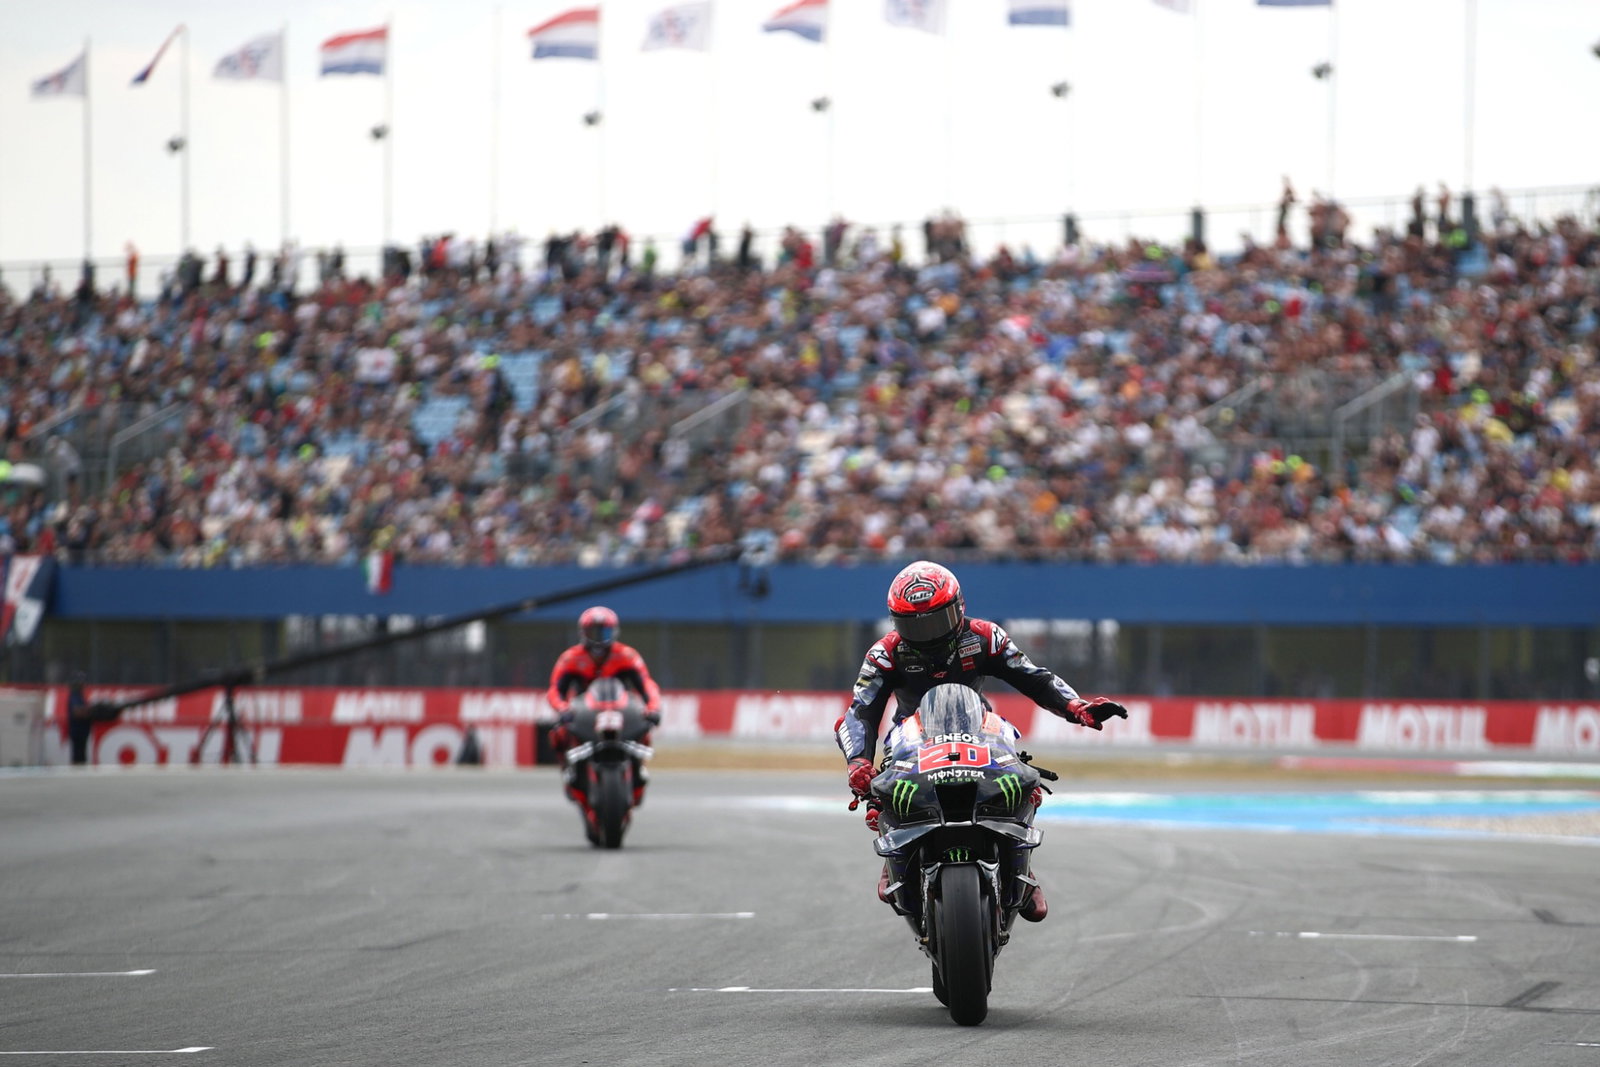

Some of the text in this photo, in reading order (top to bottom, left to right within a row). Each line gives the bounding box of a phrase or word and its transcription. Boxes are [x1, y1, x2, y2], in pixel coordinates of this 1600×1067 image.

[332, 692, 425, 722] MOTUL
[934, 732, 980, 744] ENEOS
[1191, 702, 1316, 746] MOTUL
[1356, 704, 1487, 749] MOTUL
[918, 741, 991, 773] 20
[927, 768, 986, 781] MONSTER
[935, 777, 979, 785] ENERGY
